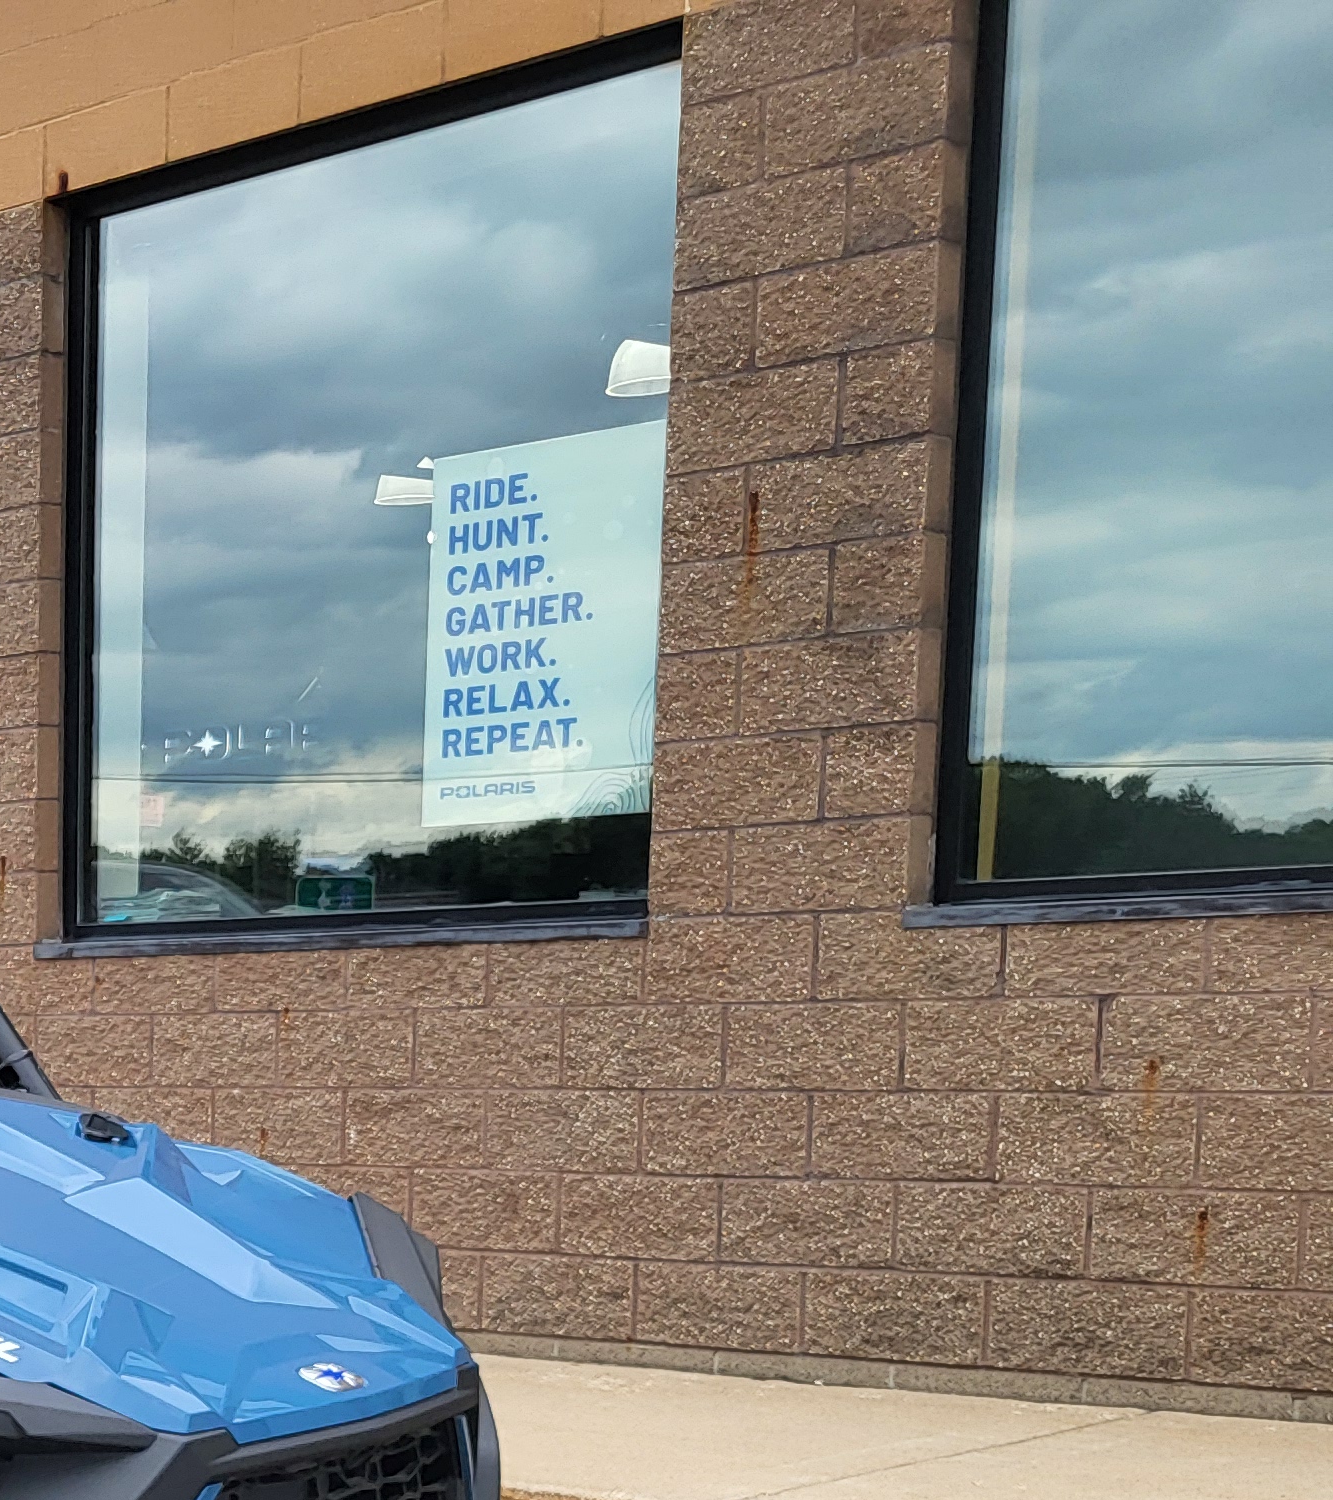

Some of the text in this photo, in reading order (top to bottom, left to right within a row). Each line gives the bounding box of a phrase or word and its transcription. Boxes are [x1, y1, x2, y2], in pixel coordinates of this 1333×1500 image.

[449, 472, 538, 515] RIDE.
[448, 512, 549, 556] HUNT.
[446, 554, 554, 596] CAMP.
[445, 591, 593, 637] GATHER.
[444, 637, 557, 678] WORK.
[442, 677, 570, 718] RELAX.
[441, 717, 584, 759] REPEAT.
[439, 780, 536, 800] POLARIS
